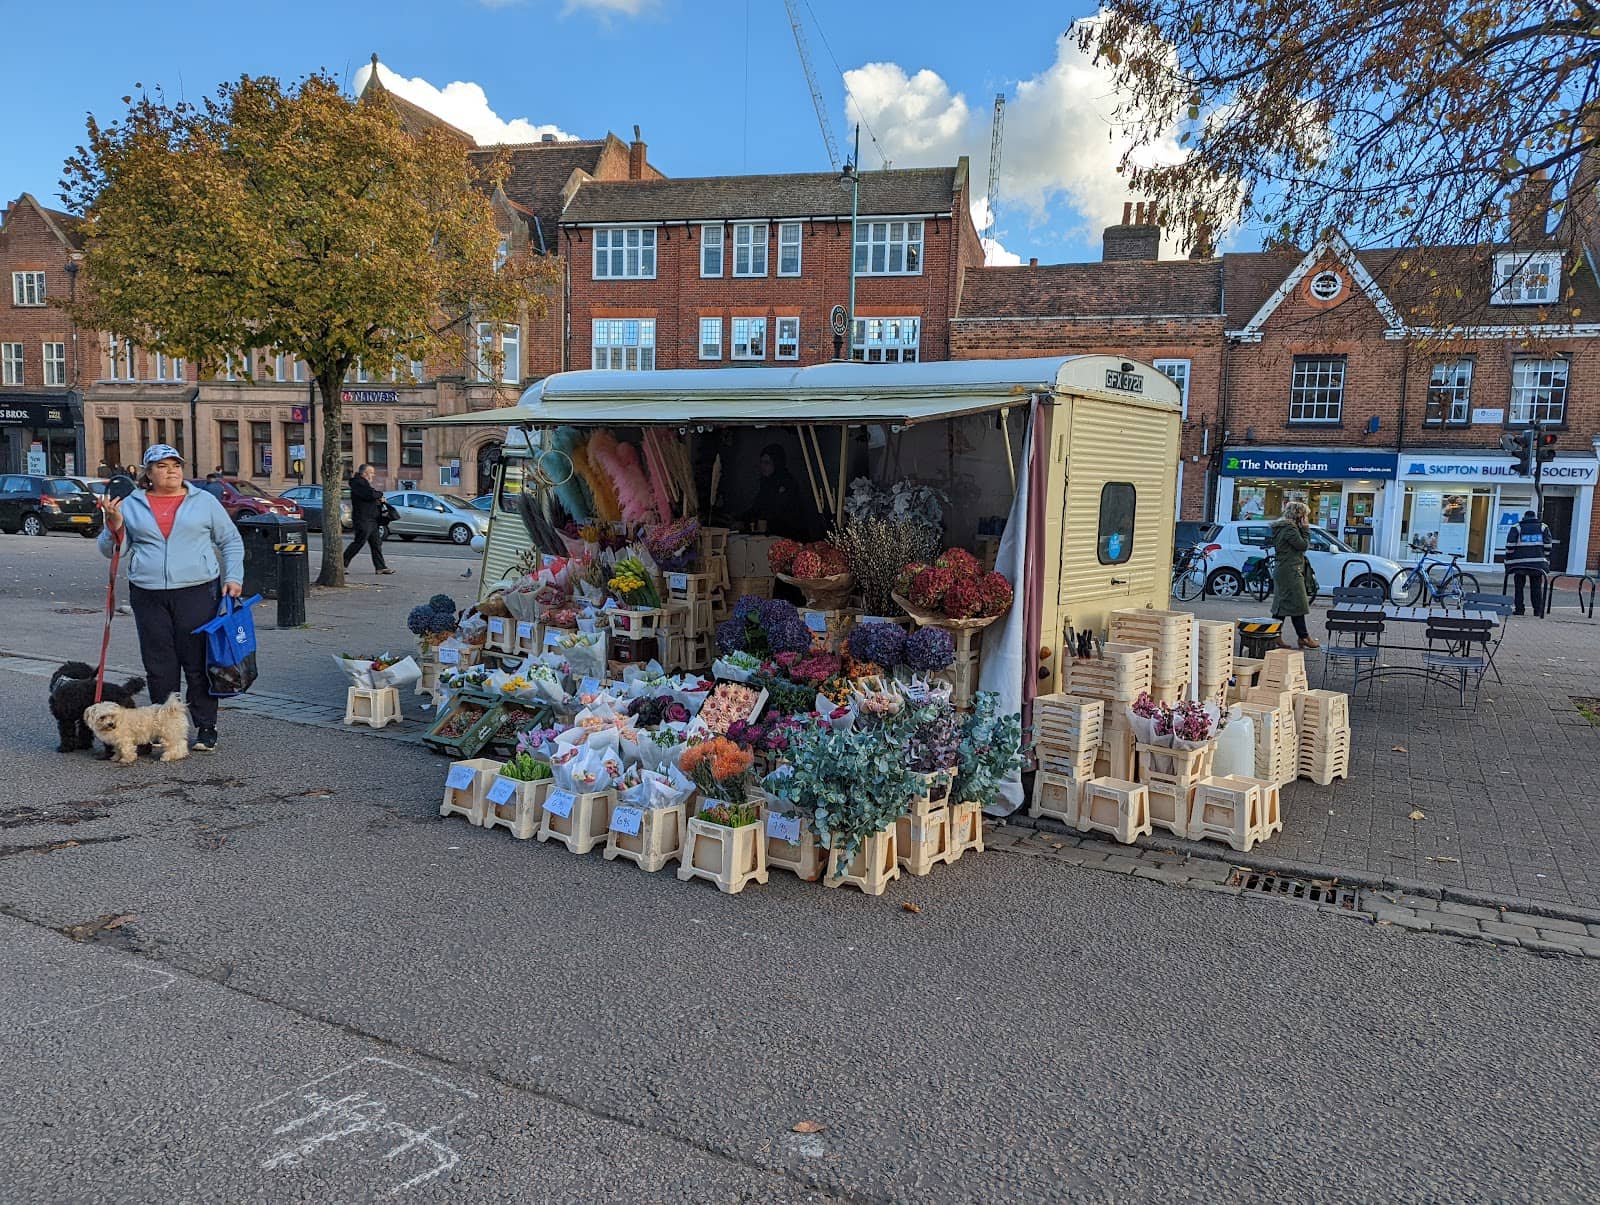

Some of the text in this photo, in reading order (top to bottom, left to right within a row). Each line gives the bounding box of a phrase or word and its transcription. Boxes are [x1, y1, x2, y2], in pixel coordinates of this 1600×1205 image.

[1106, 371, 1122, 388] GFX
[5, 410, 30, 419] BROS.
[1240, 459, 1328, 474] The Nottingham
[1429, 464, 1479, 475] SKIPTON
[1542, 467, 1594, 480] SOCIETY
